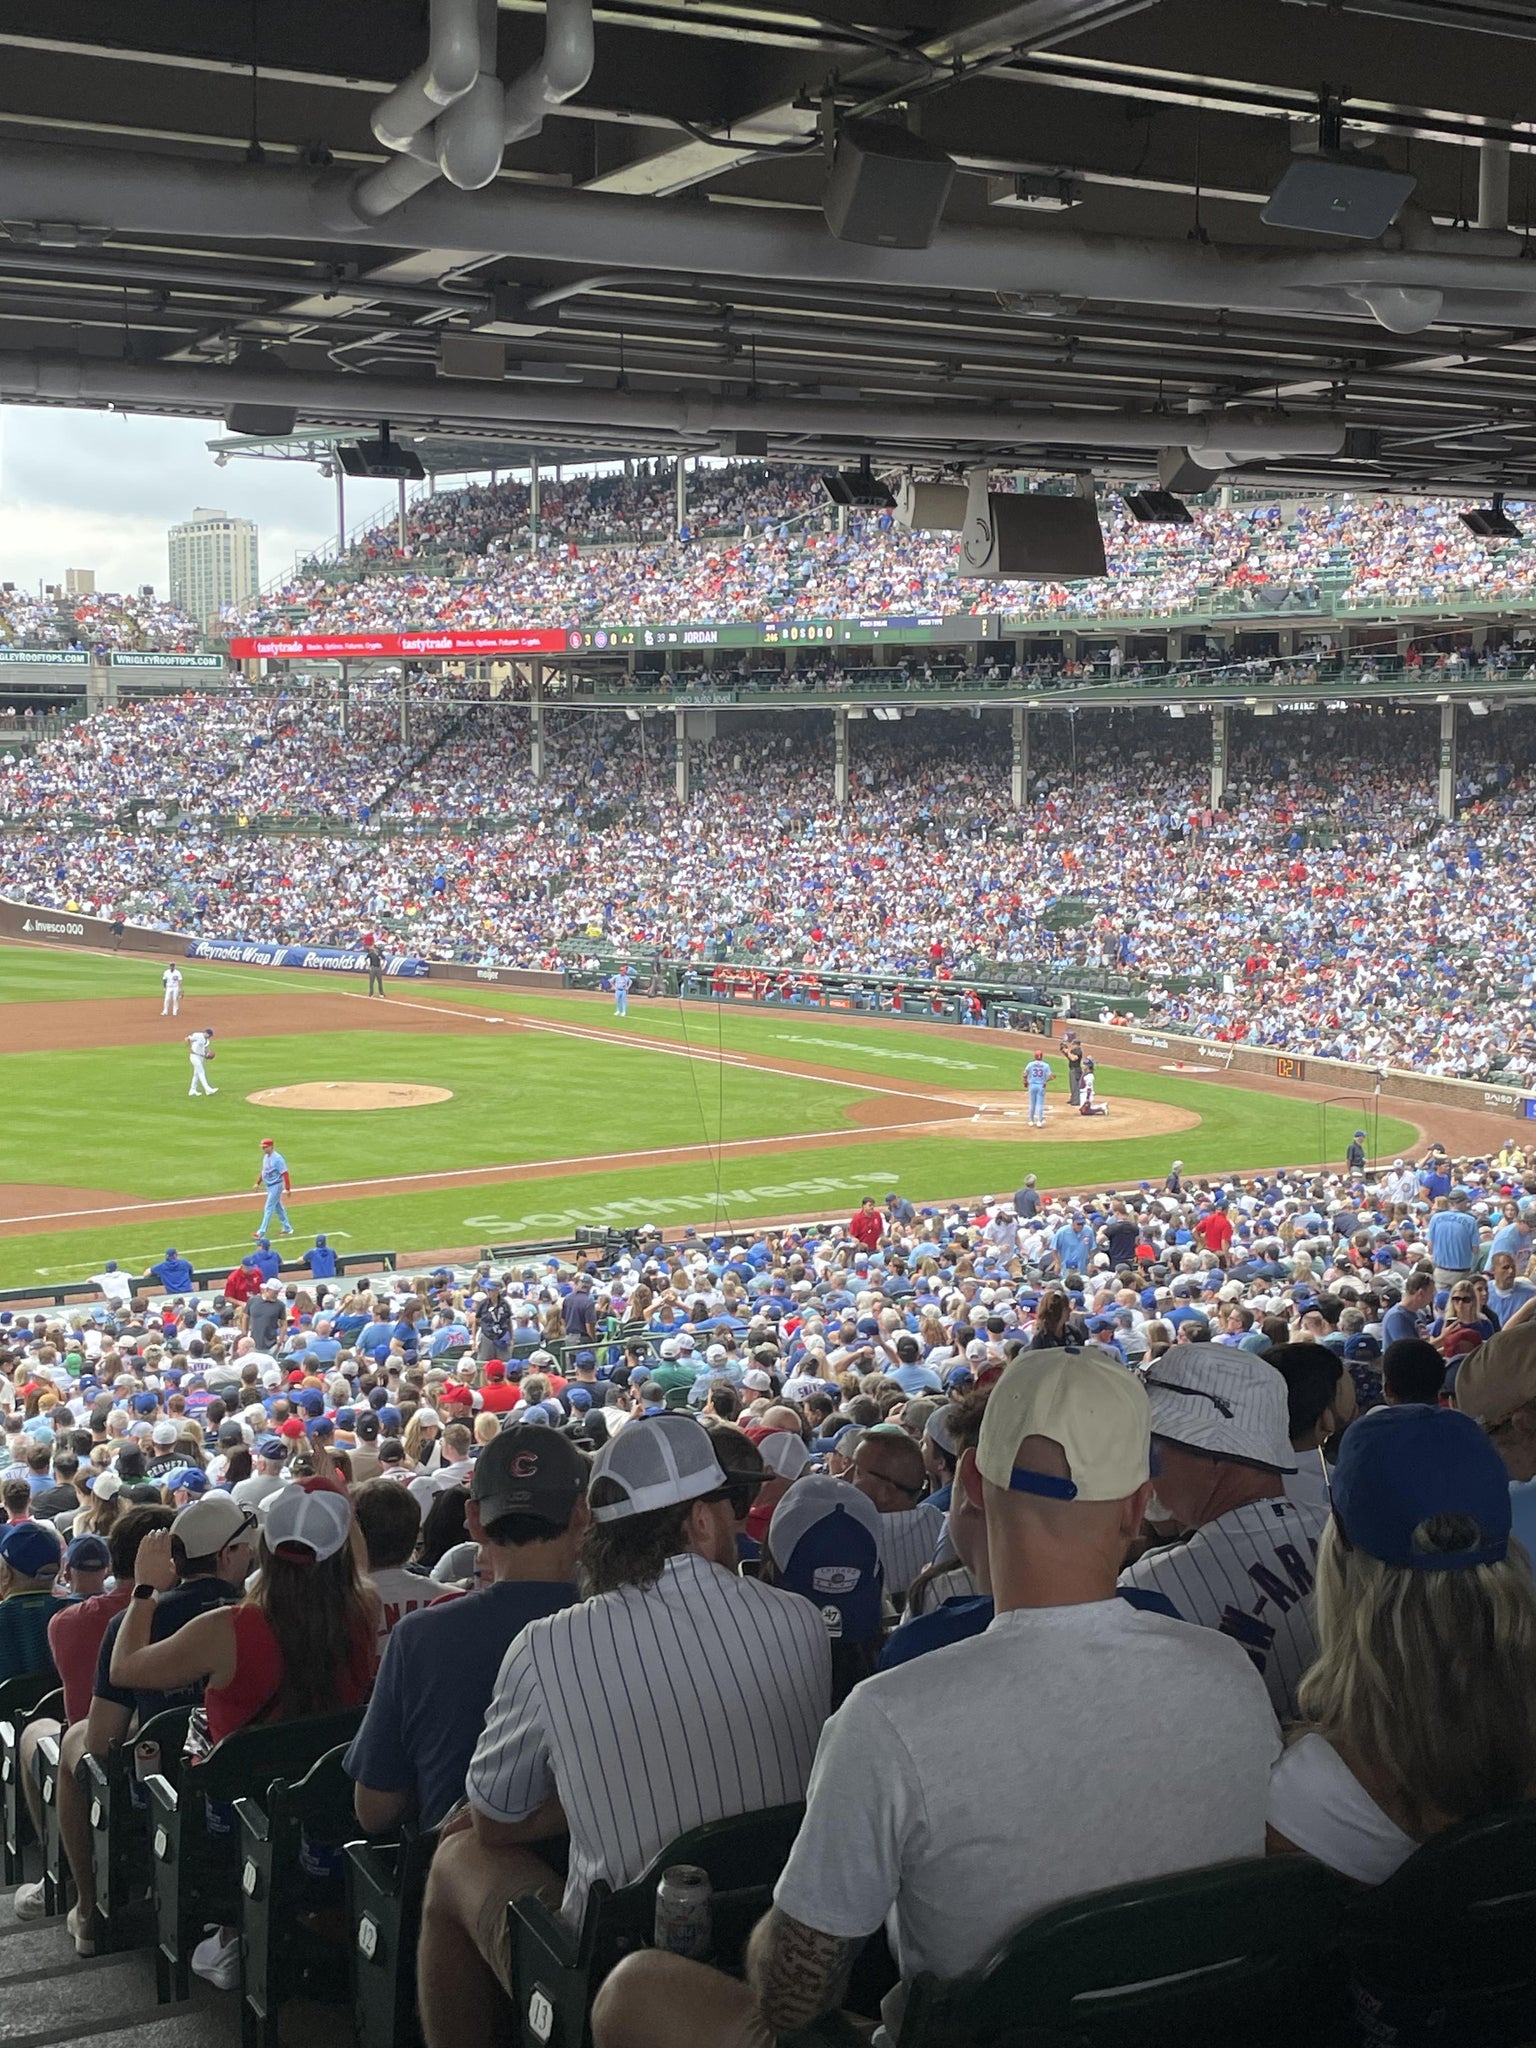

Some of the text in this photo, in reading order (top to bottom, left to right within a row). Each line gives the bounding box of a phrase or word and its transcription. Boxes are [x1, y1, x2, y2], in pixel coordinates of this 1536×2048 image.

[402, 636, 453, 652] tastytrade
[683, 630, 718, 644] JORDAN
[257, 640, 303, 655] tastytrade
[35, 921, 66, 934] Invesco
[196, 941, 271, 967] Reynolds Wrap
[303, 951, 353, 970] Reynolds
[1032, 1068, 1044, 1078] 33
[462, 1178, 868, 1235] Southwest
[146, 1460, 188, 1477] CERVEZA
[510, 1451, 538, 1479] C
[362, 1924, 374, 1952] 12
[533, 1999, 548, 2031] 13
